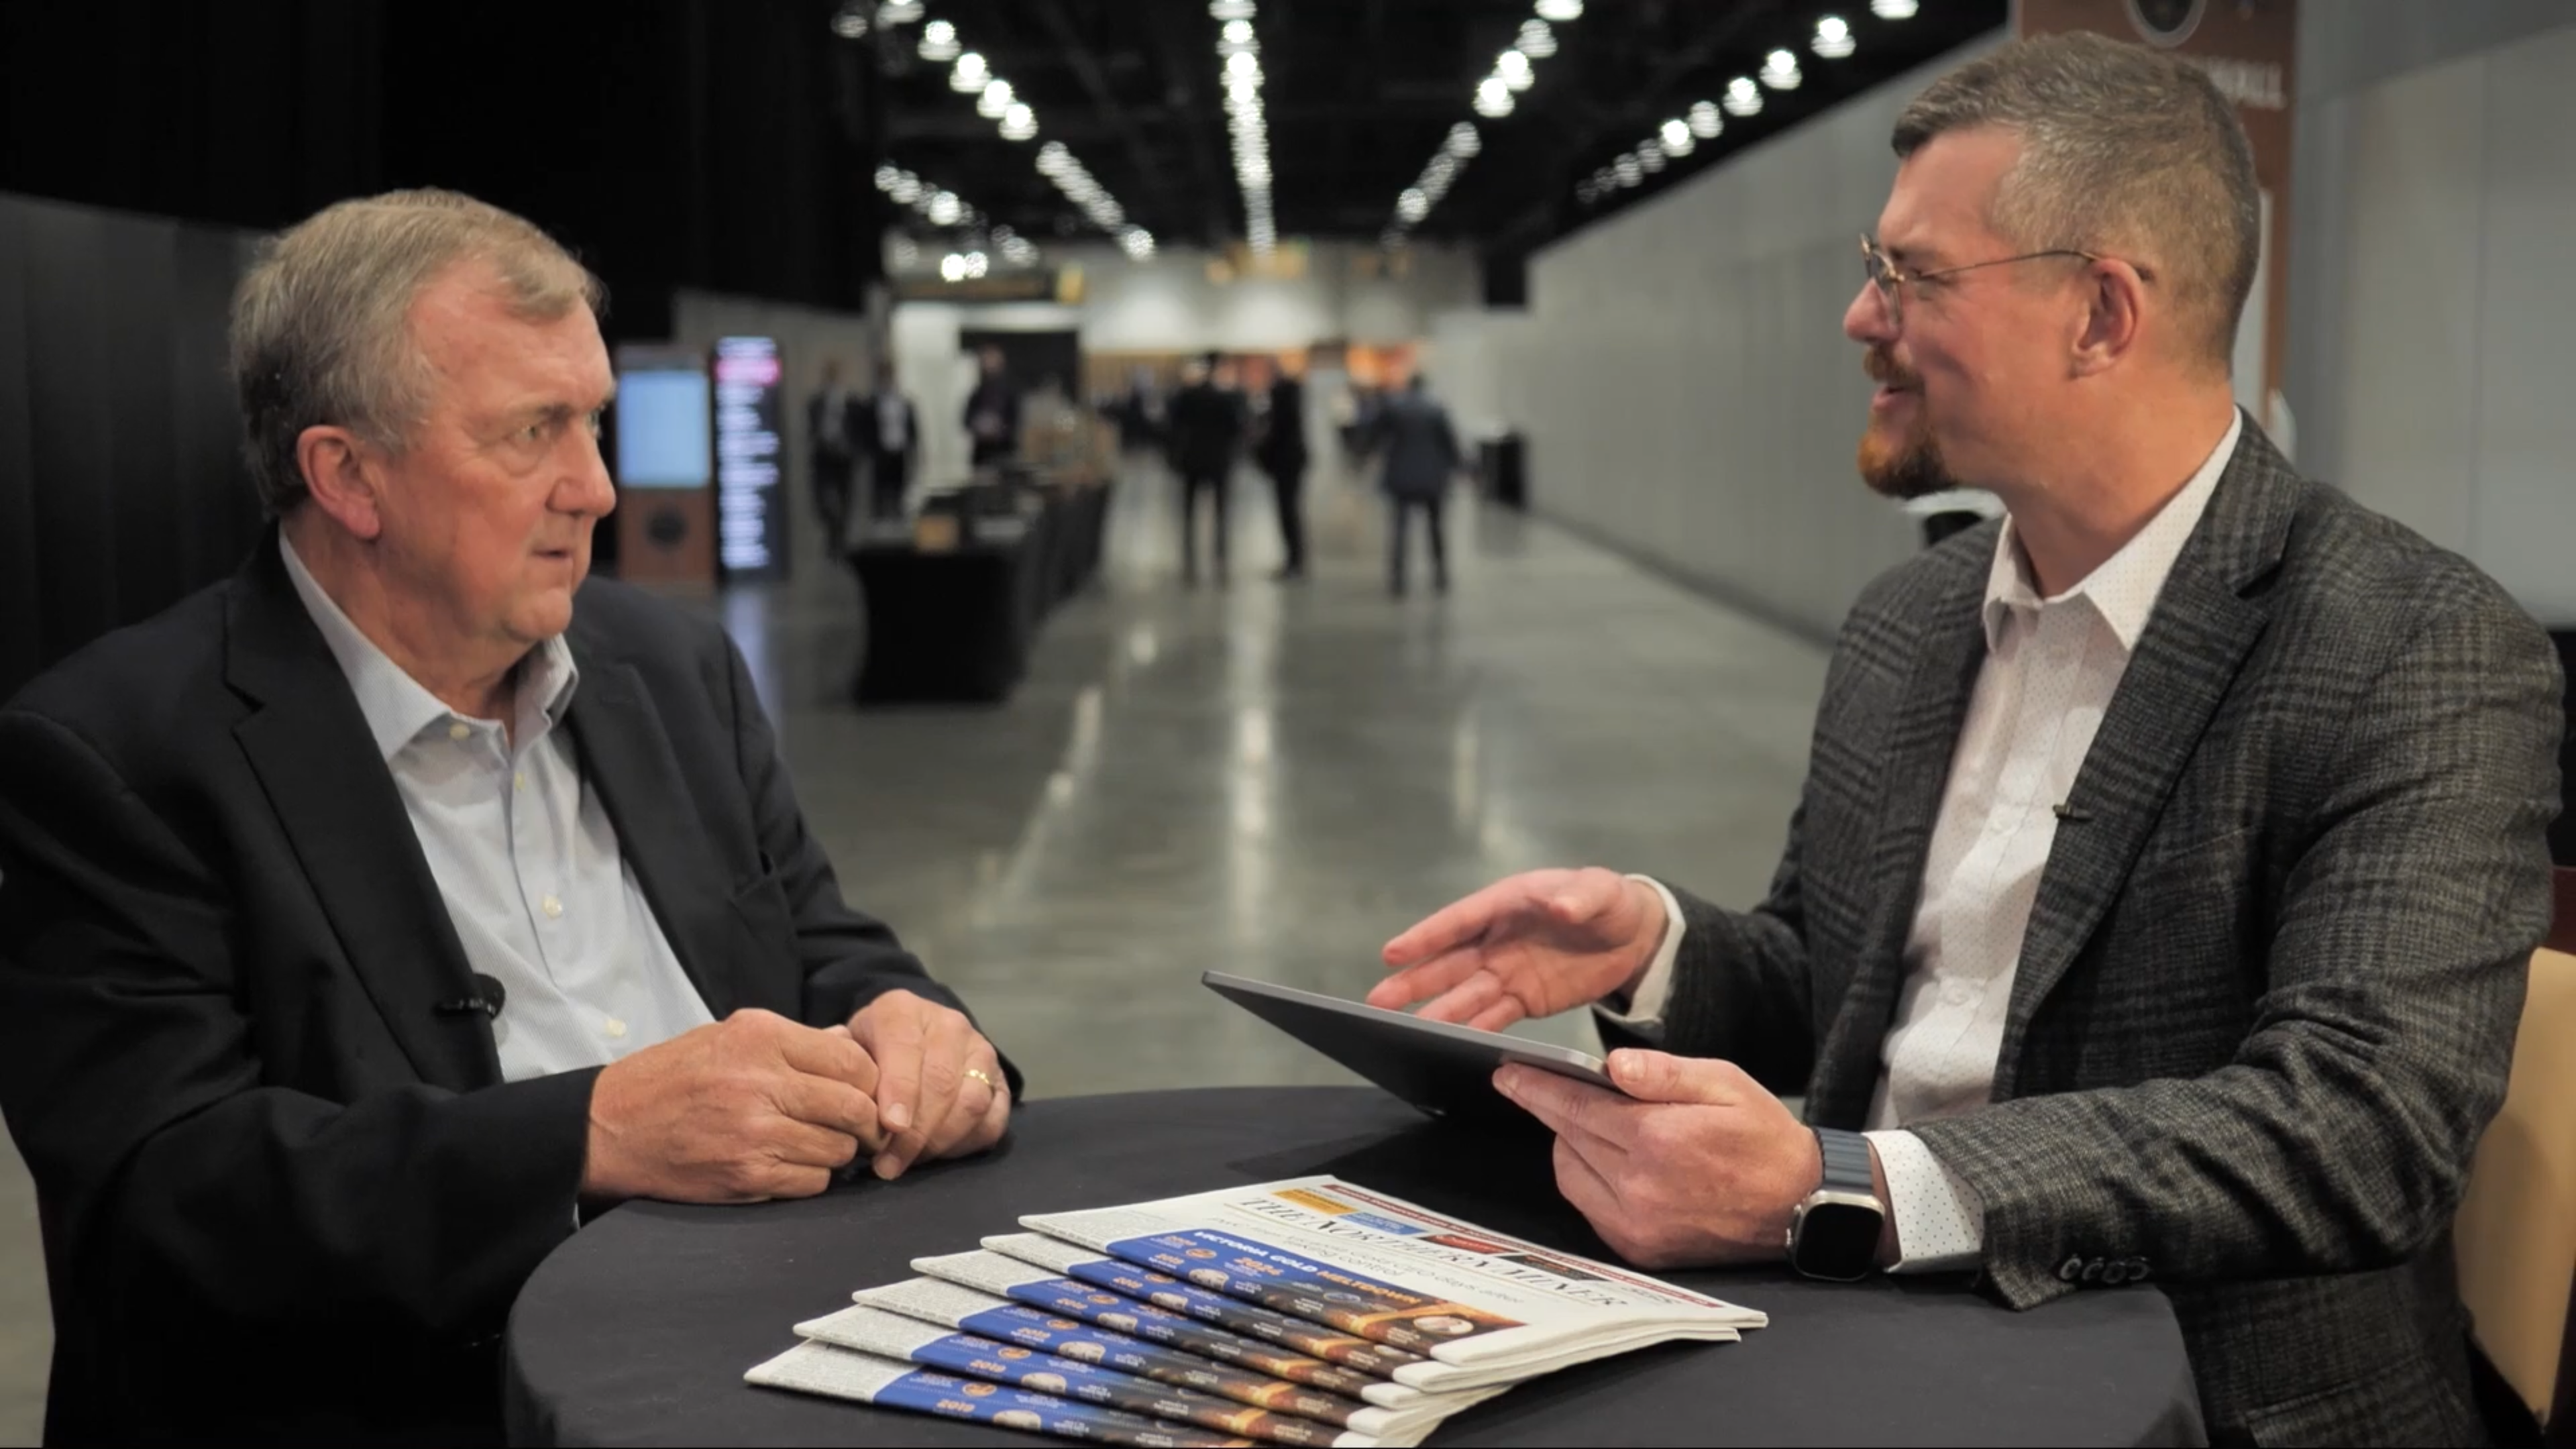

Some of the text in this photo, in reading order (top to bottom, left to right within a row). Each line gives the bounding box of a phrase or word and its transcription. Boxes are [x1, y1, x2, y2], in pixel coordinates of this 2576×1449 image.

[1193, 1231, 1269, 1257] VICTORIA
[1270, 1254, 1319, 1273] GOLD
[1317, 1270, 1422, 1305] MELTDOWN
[1239, 1197, 1306, 1222] THE
[1302, 1216, 1501, 1268] NORTHERN
[1496, 1267, 1628, 1305] MINER
